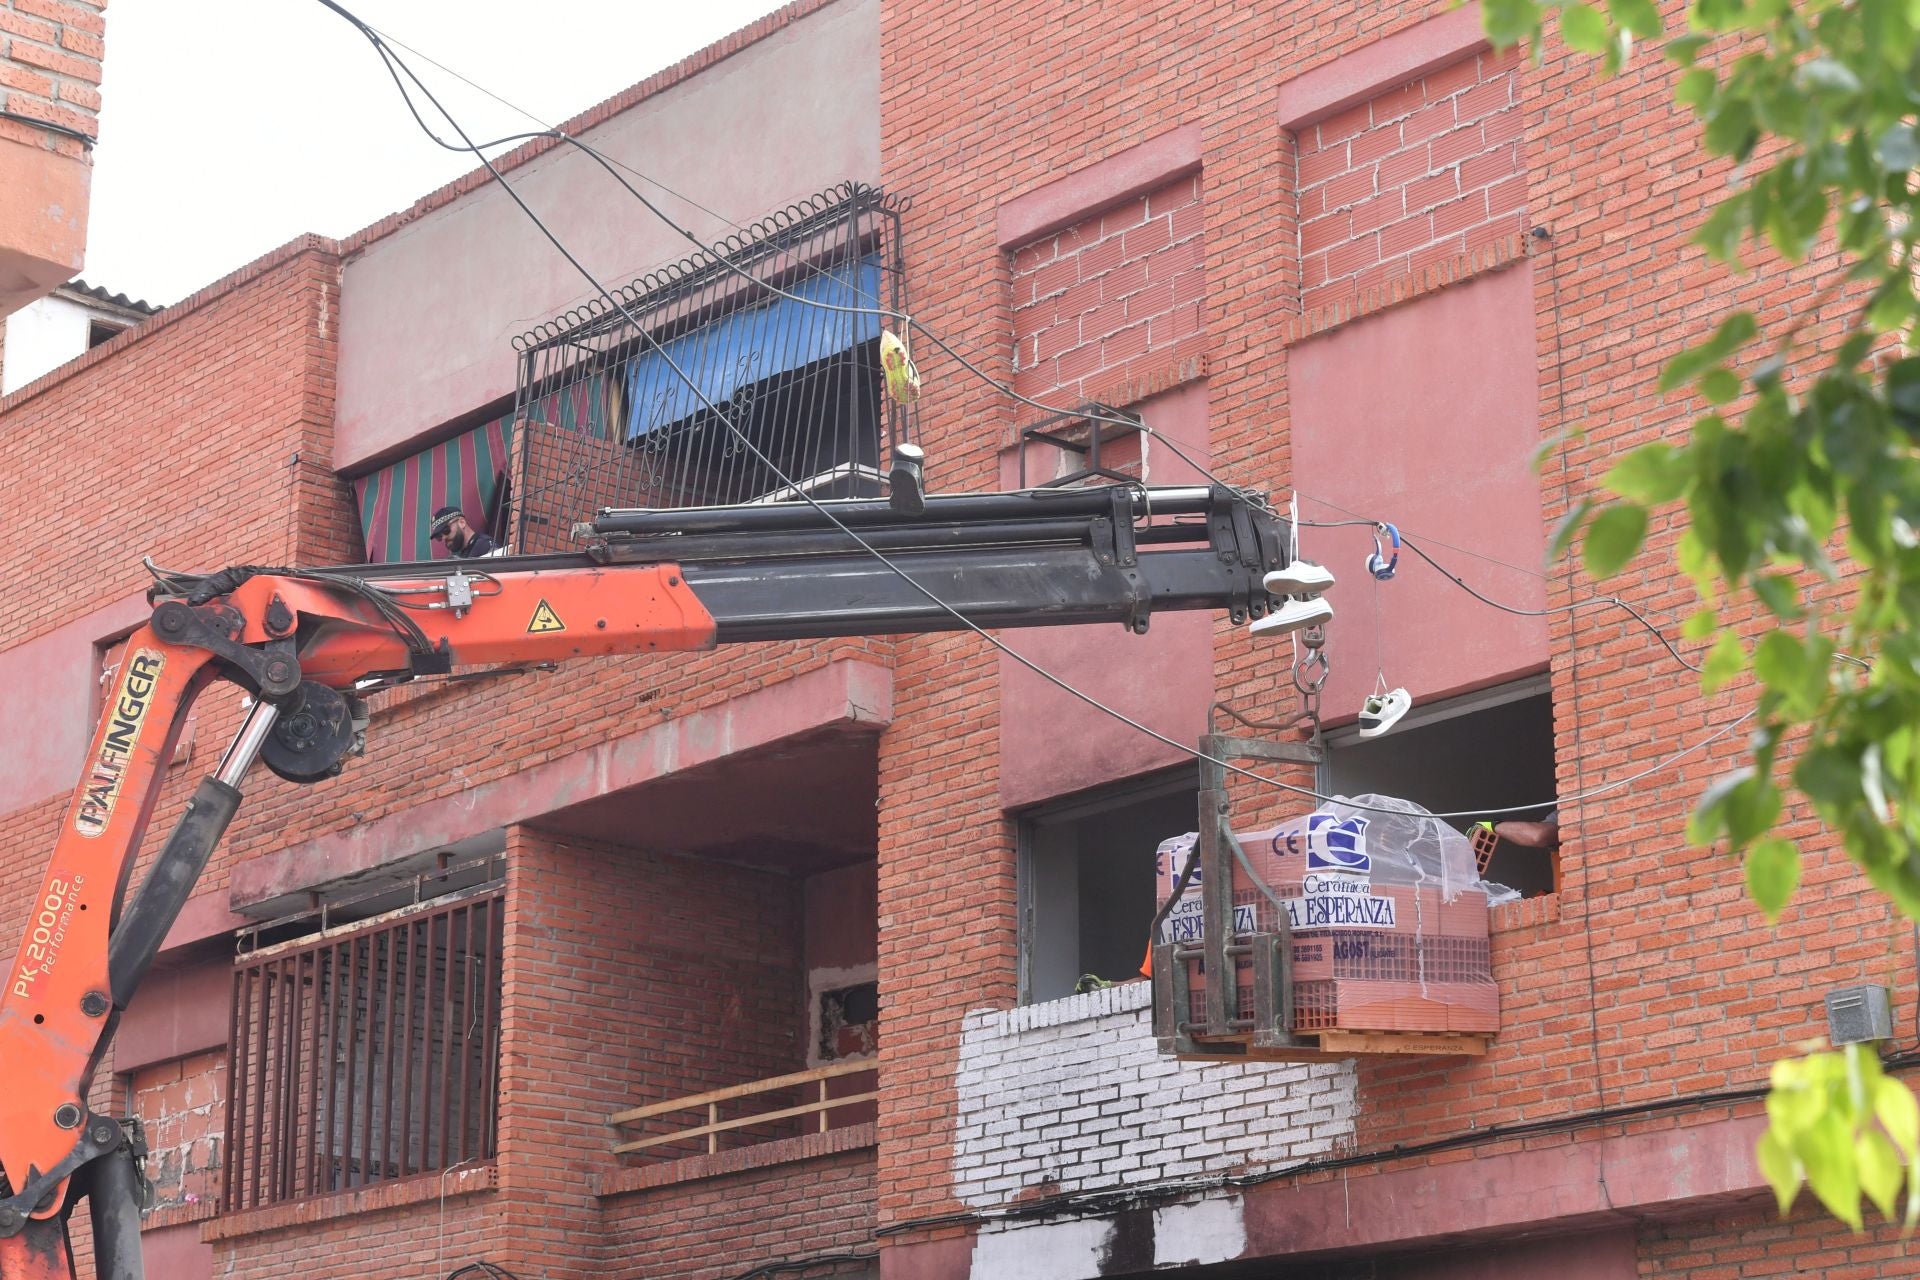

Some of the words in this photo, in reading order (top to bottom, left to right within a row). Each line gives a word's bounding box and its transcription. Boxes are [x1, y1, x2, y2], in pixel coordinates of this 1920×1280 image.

[79, 654, 161, 826] PALFINGER
[1272, 829, 1299, 856] CE
[1304, 875, 1370, 894] Cerámica
[40, 875, 84, 975] Performance
[1305, 895, 1394, 926] ESPERANZA
[13, 965, 39, 998] PK
[26, 878, 69, 961] 20002
[1333, 940, 1370, 959] AGOST
